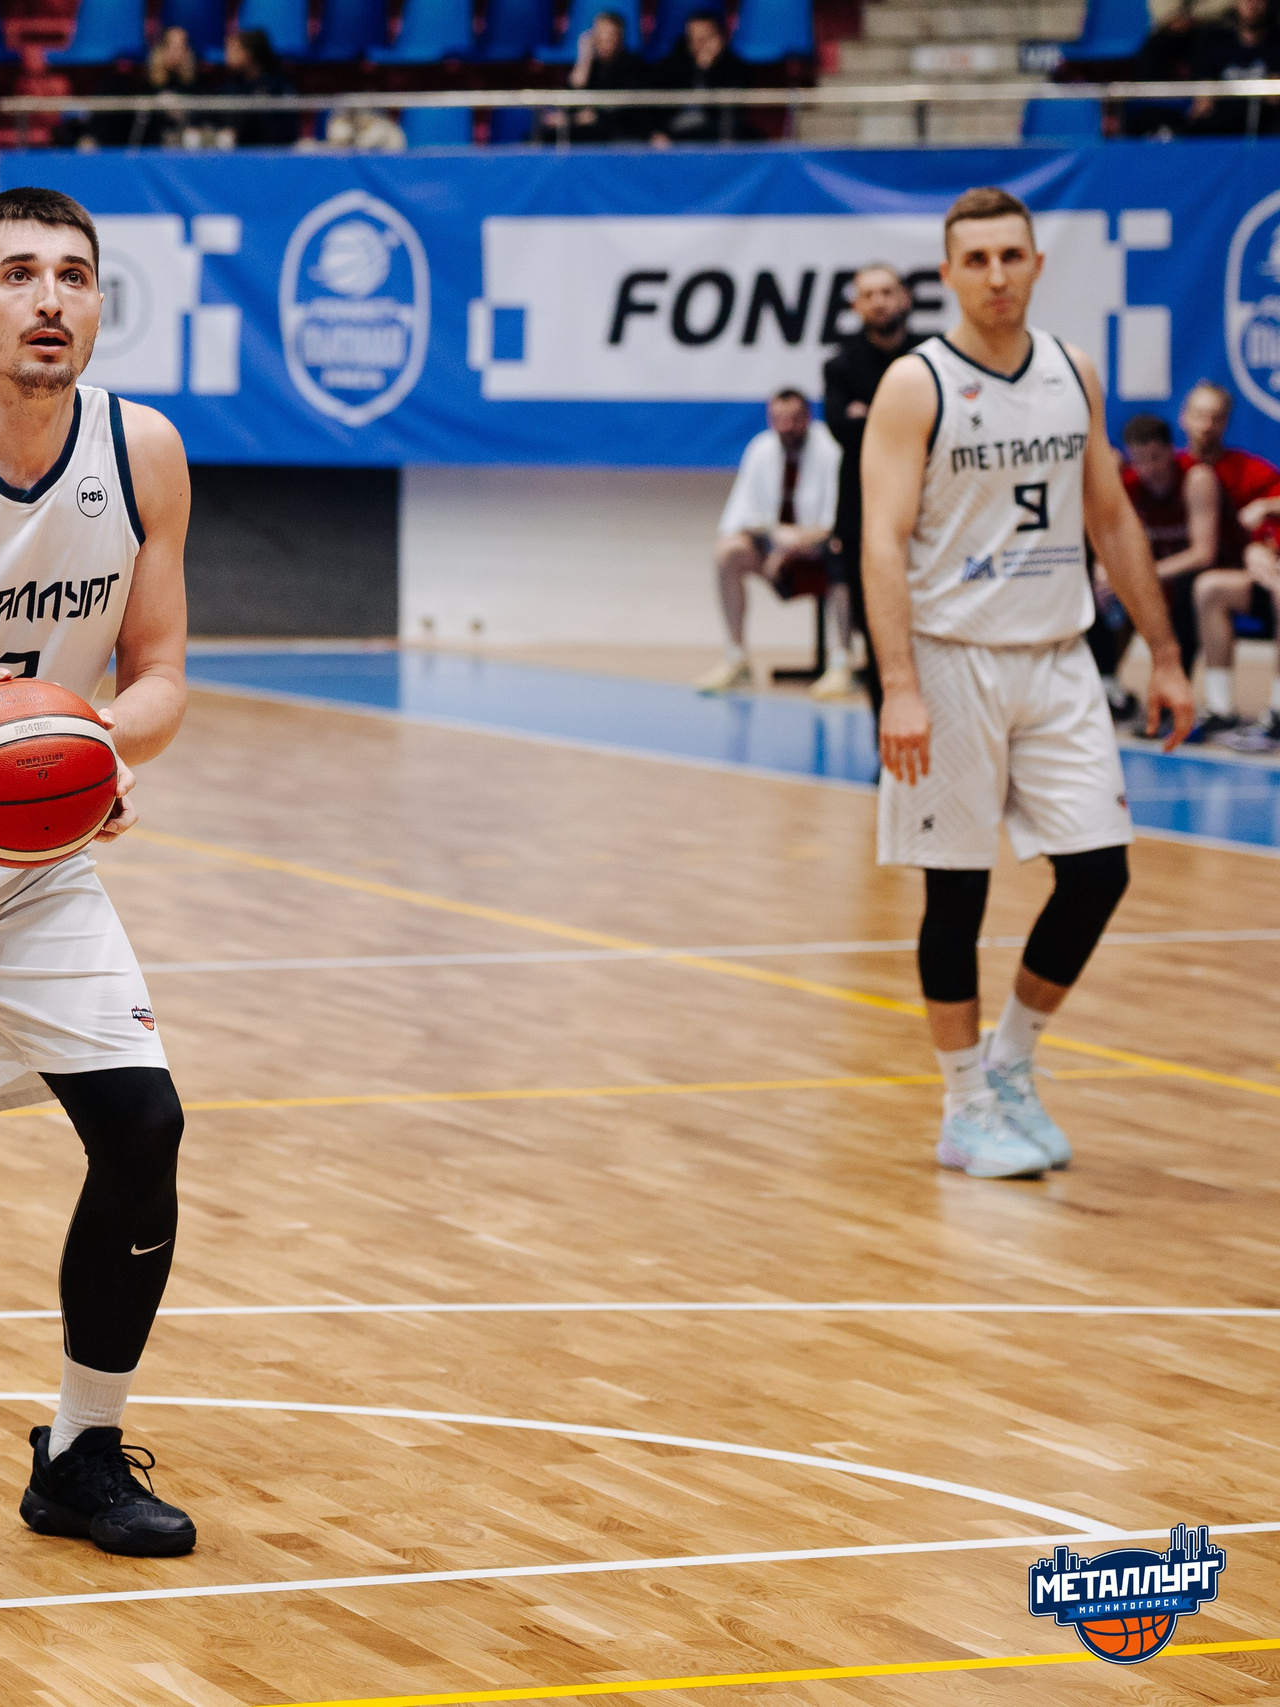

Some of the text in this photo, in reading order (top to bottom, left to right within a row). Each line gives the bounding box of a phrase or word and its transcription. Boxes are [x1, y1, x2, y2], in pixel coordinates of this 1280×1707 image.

[608, 267, 946, 346] FONBE
[81, 490, 104, 504] РФБ
[1014, 481, 1049, 534] 9
[16, 753, 64, 767] COMPETITION
